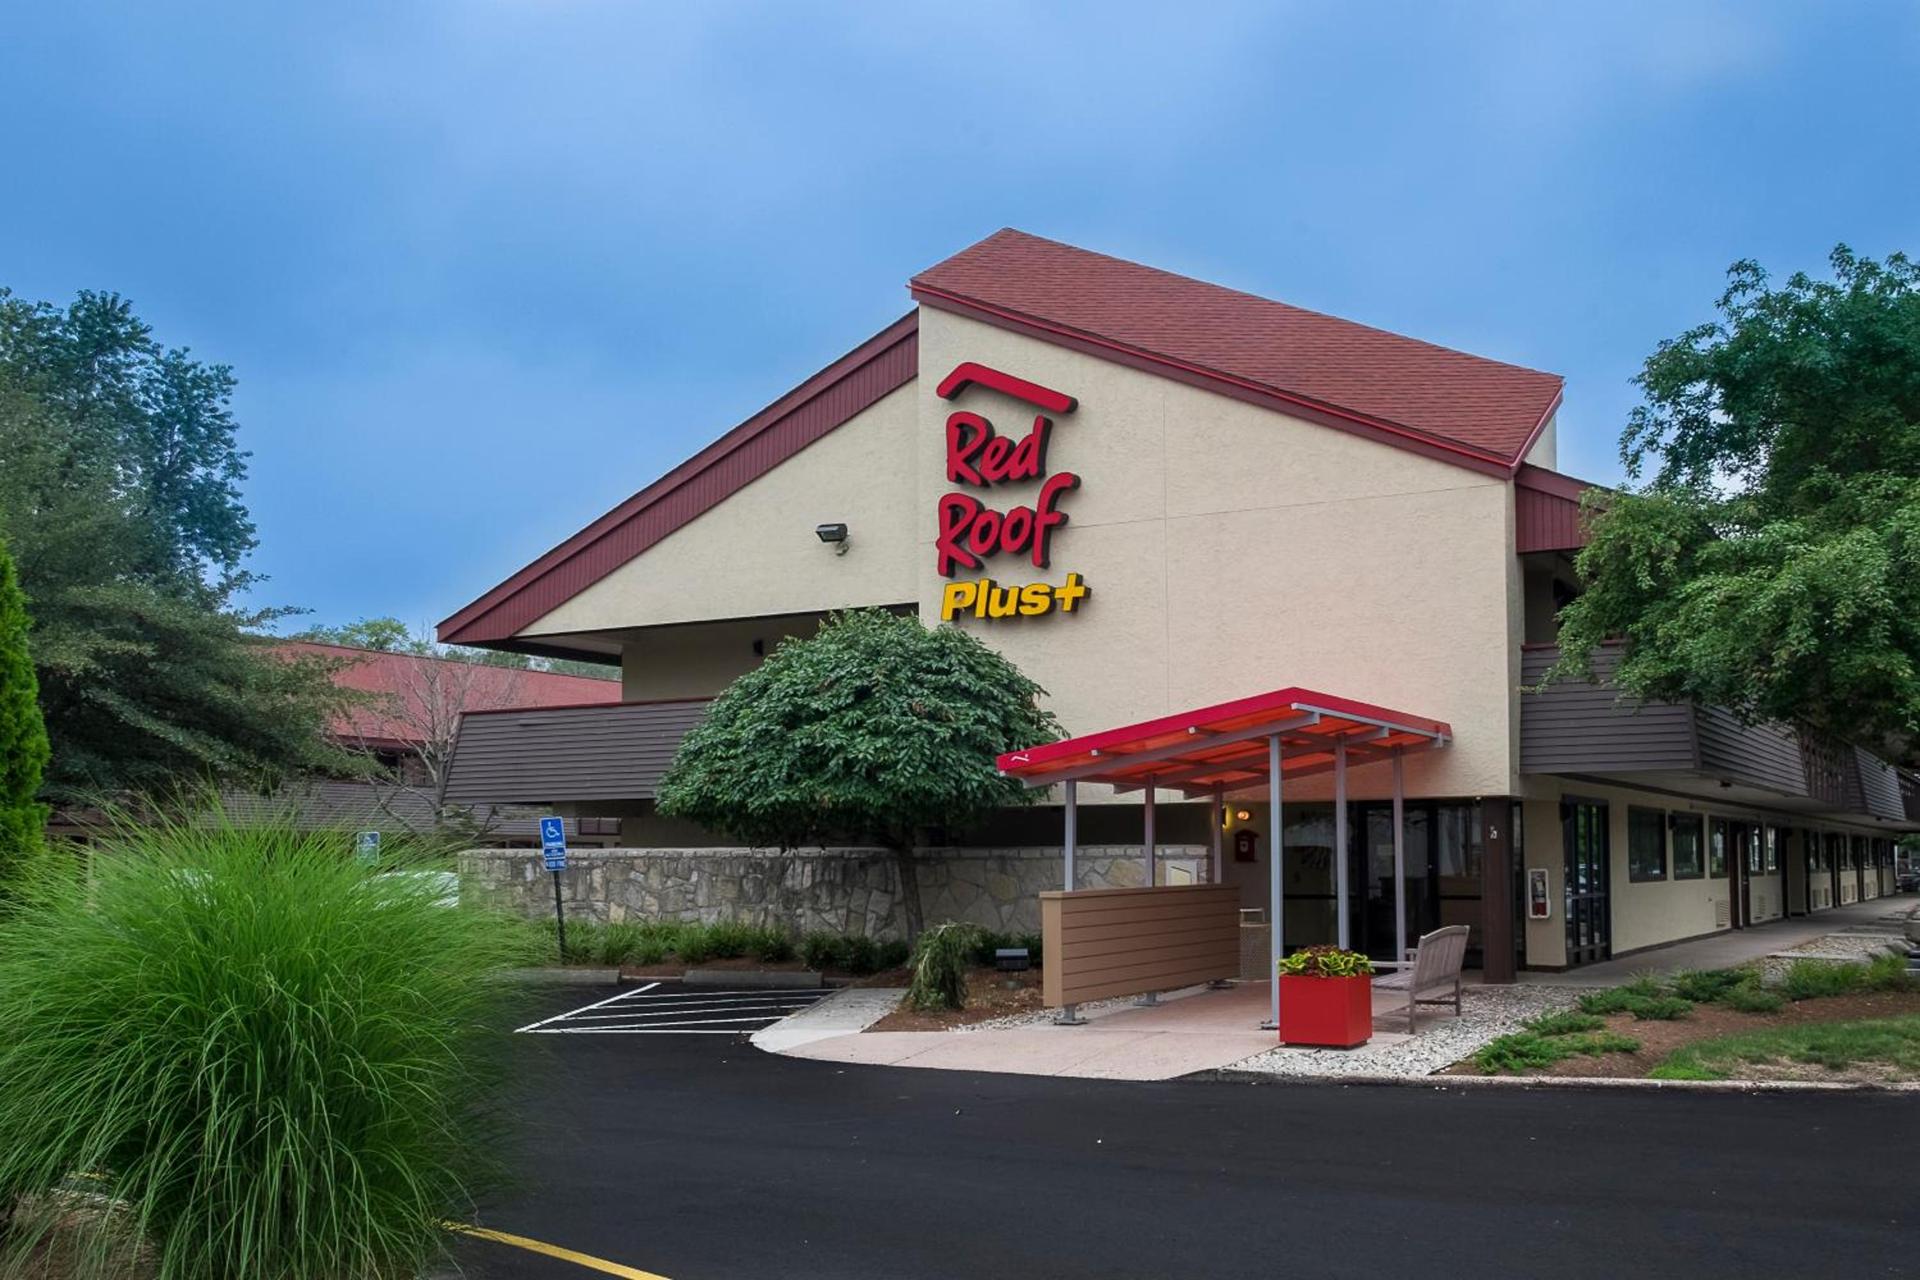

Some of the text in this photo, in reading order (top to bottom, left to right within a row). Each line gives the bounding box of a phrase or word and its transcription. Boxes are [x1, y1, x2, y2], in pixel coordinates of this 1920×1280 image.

[946, 411, 1050, 488] Red
[935, 472, 1080, 578] Roof
[940, 572, 1089, 622] Plus+
